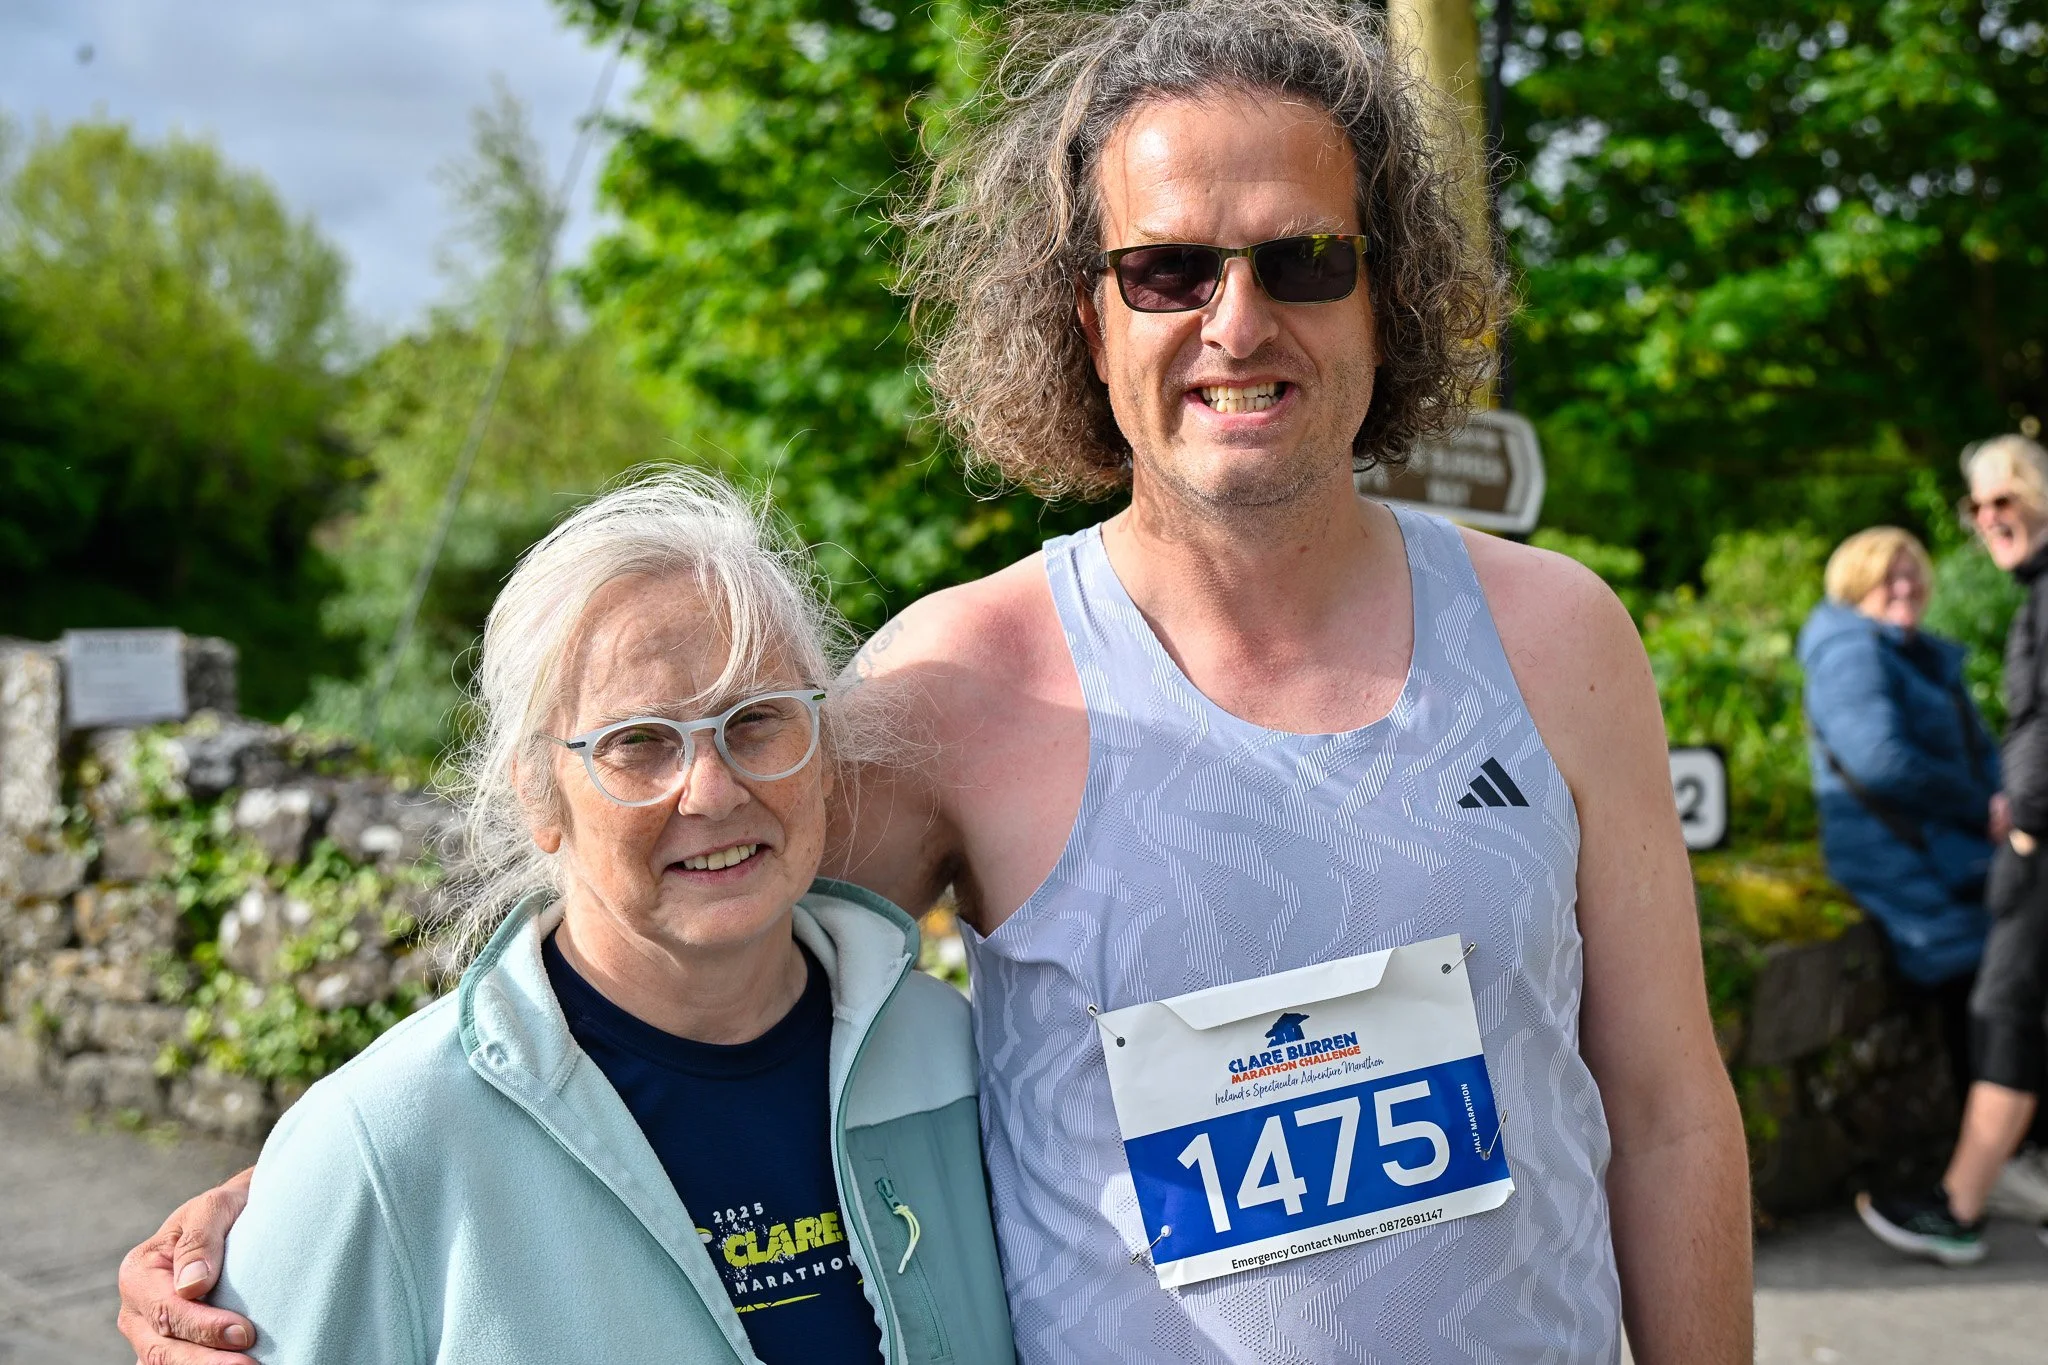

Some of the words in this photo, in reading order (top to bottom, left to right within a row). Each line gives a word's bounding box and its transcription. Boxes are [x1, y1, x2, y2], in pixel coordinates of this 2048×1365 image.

[1228, 1048, 1284, 1074] CLARE
[1287, 1031, 1359, 1060] BURREN
[1231, 1060, 1298, 1085] MARATHON
[1299, 1045, 1362, 1068] CHALLENGE
[1252, 1077, 1300, 1098] Spectacular
[1300, 1068, 1343, 1086] Adventure
[1341, 1057, 1385, 1075] Marathon
[1460, 1083, 1478, 1131] MARATHON
[1176, 1080, 1451, 1234] 1475
[1472, 1131, 1482, 1154] HALF
[712, 1202, 764, 1224] 2025
[723, 1211, 844, 1268] CLARE
[1231, 1248, 1290, 1270] Emergency
[1290, 1235, 1333, 1255] Contact
[1333, 1225, 1380, 1245] Number:
[1379, 1208, 1444, 1234] 0872691147
